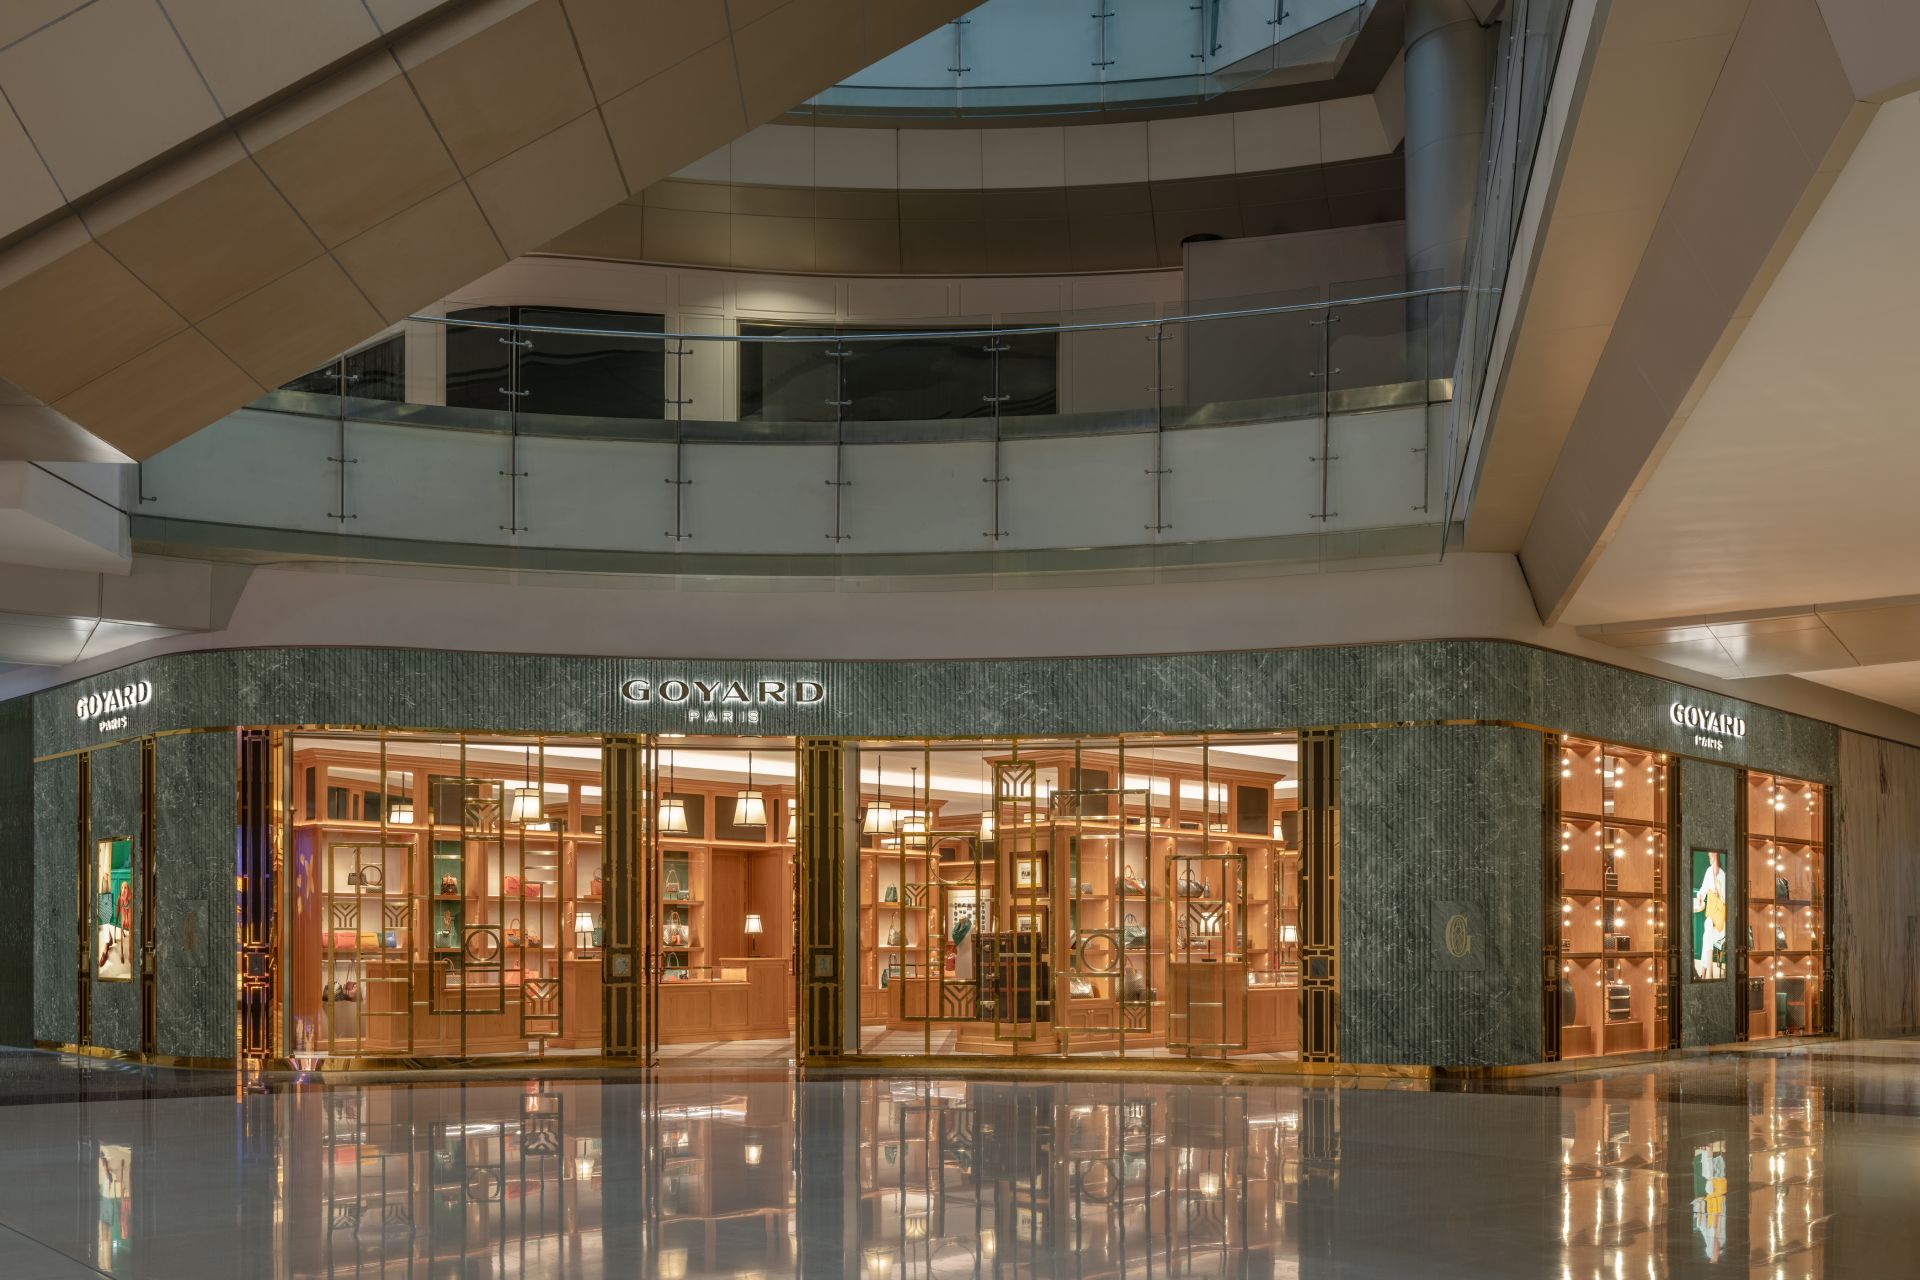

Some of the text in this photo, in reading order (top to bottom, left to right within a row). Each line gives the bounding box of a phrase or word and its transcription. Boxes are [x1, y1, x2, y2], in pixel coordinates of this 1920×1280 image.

[75, 681, 151, 719] GOYARD
[622, 679, 824, 702] GOYARD
[98, 716, 127, 733] PARIS
[688, 710, 759, 723] PARIS
[1670, 702, 1746, 737] GOYARD
